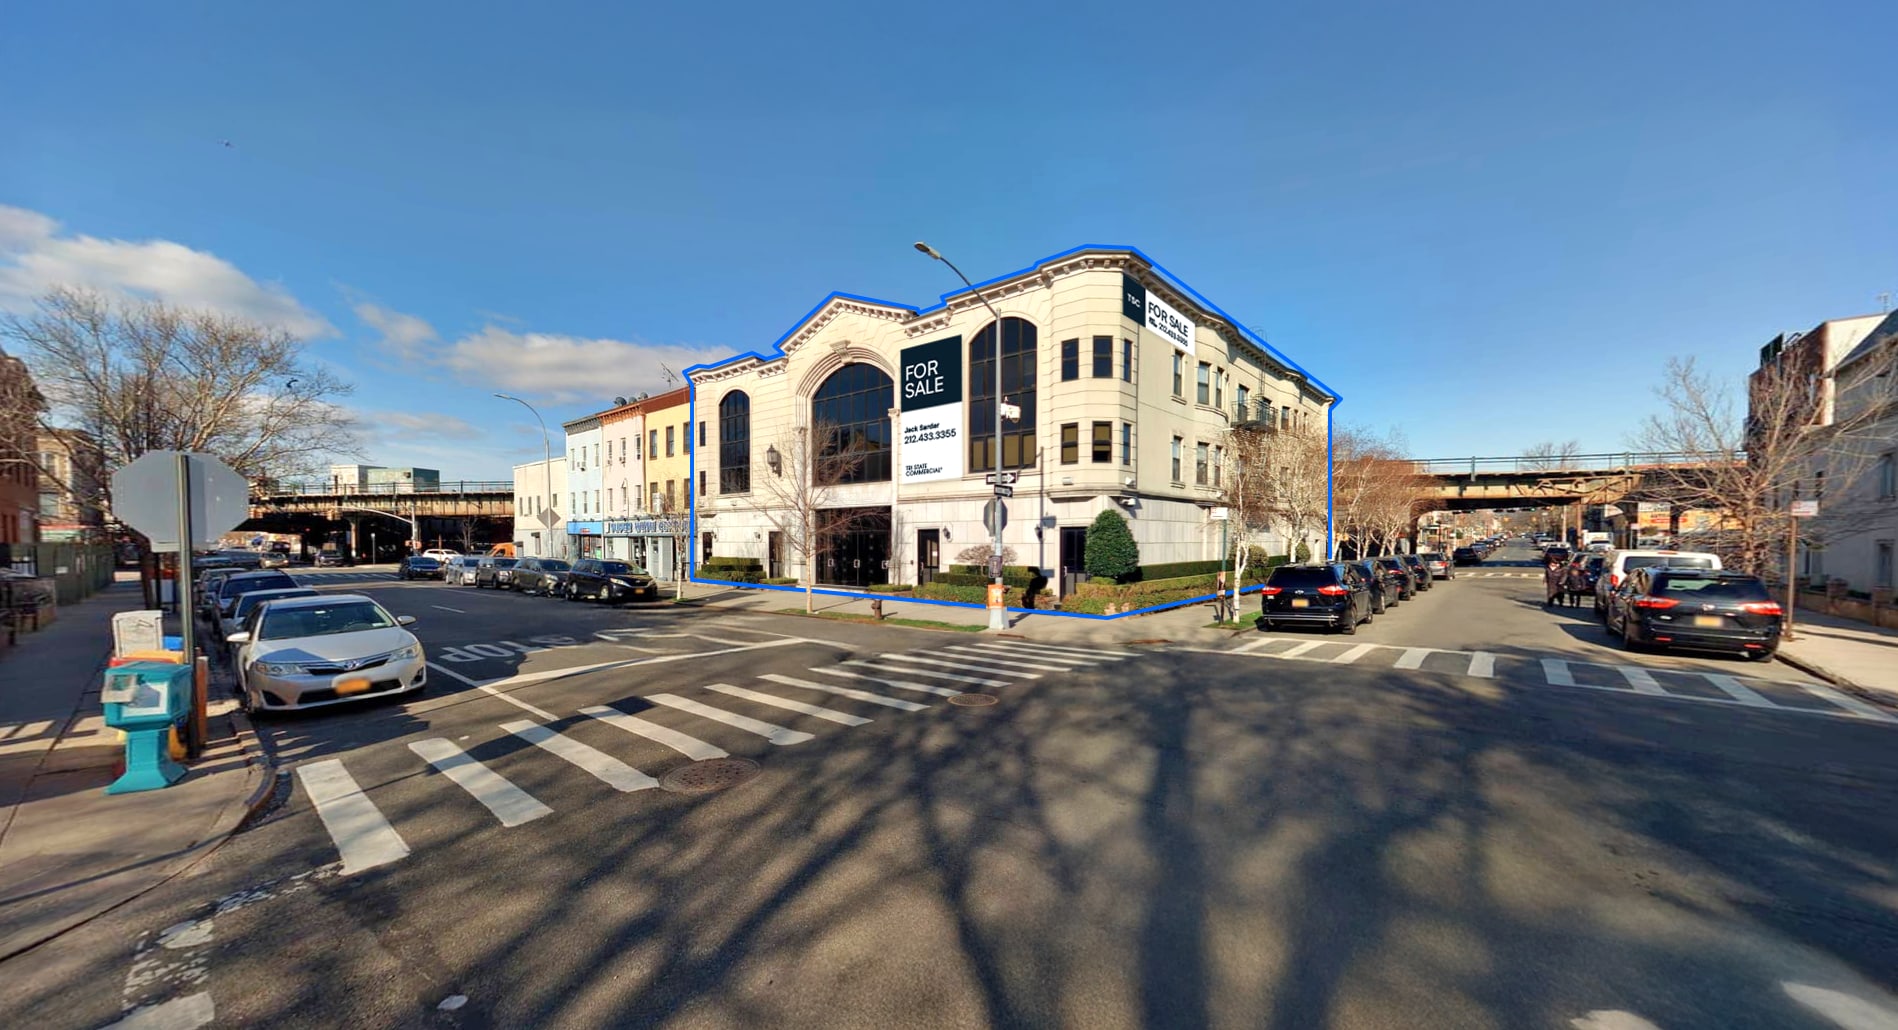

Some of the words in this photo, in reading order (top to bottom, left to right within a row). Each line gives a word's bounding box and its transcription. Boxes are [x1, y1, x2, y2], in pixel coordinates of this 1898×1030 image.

[1127, 293, 1141, 308] TSC
[1148, 301, 1168, 324] FOR
[1169, 314, 1189, 338] SALE
[905, 360, 939, 381] FOR
[905, 376, 944, 399] SALE
[904, 425, 918, 434] Jack
[904, 427, 957, 445] 212.433.3355
